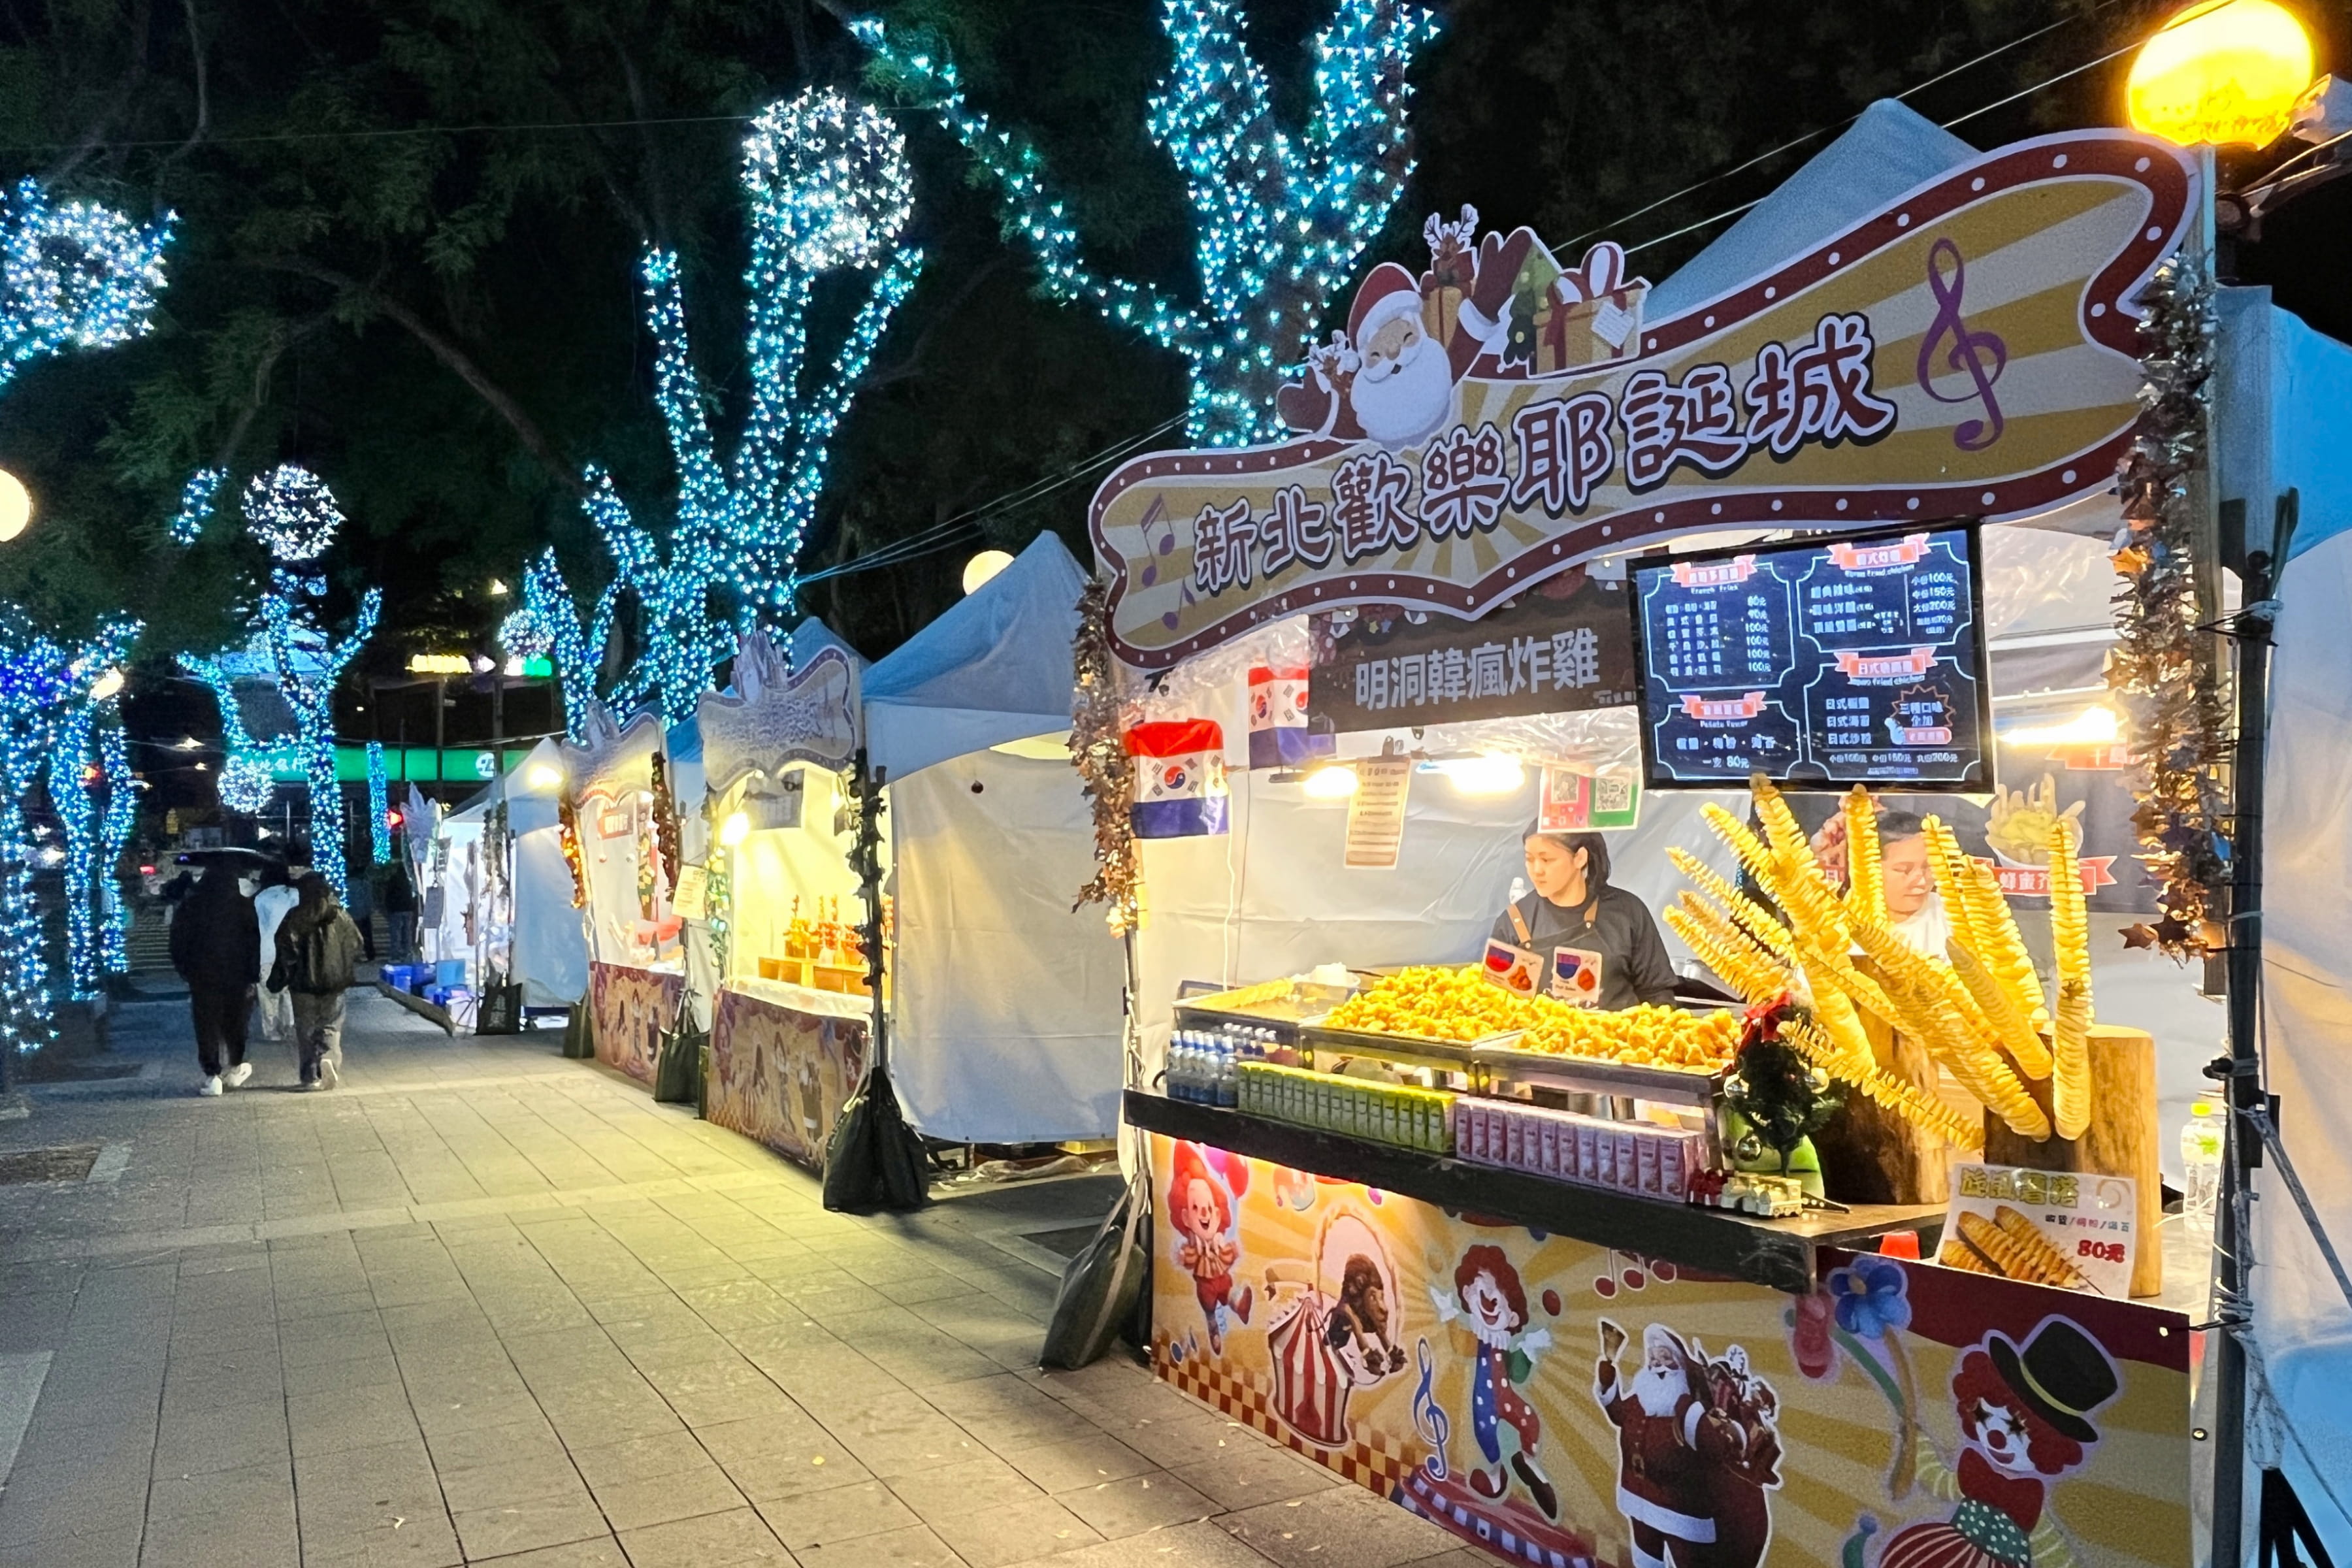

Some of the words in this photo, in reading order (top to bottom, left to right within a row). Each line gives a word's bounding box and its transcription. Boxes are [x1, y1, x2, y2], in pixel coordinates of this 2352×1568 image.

[1194, 312, 1900, 593] 新北歡樂耶誕城
[1355, 628, 1600, 711] 明洞韓瘋炸雞
[2078, 1239, 2125, 1263] 80元
